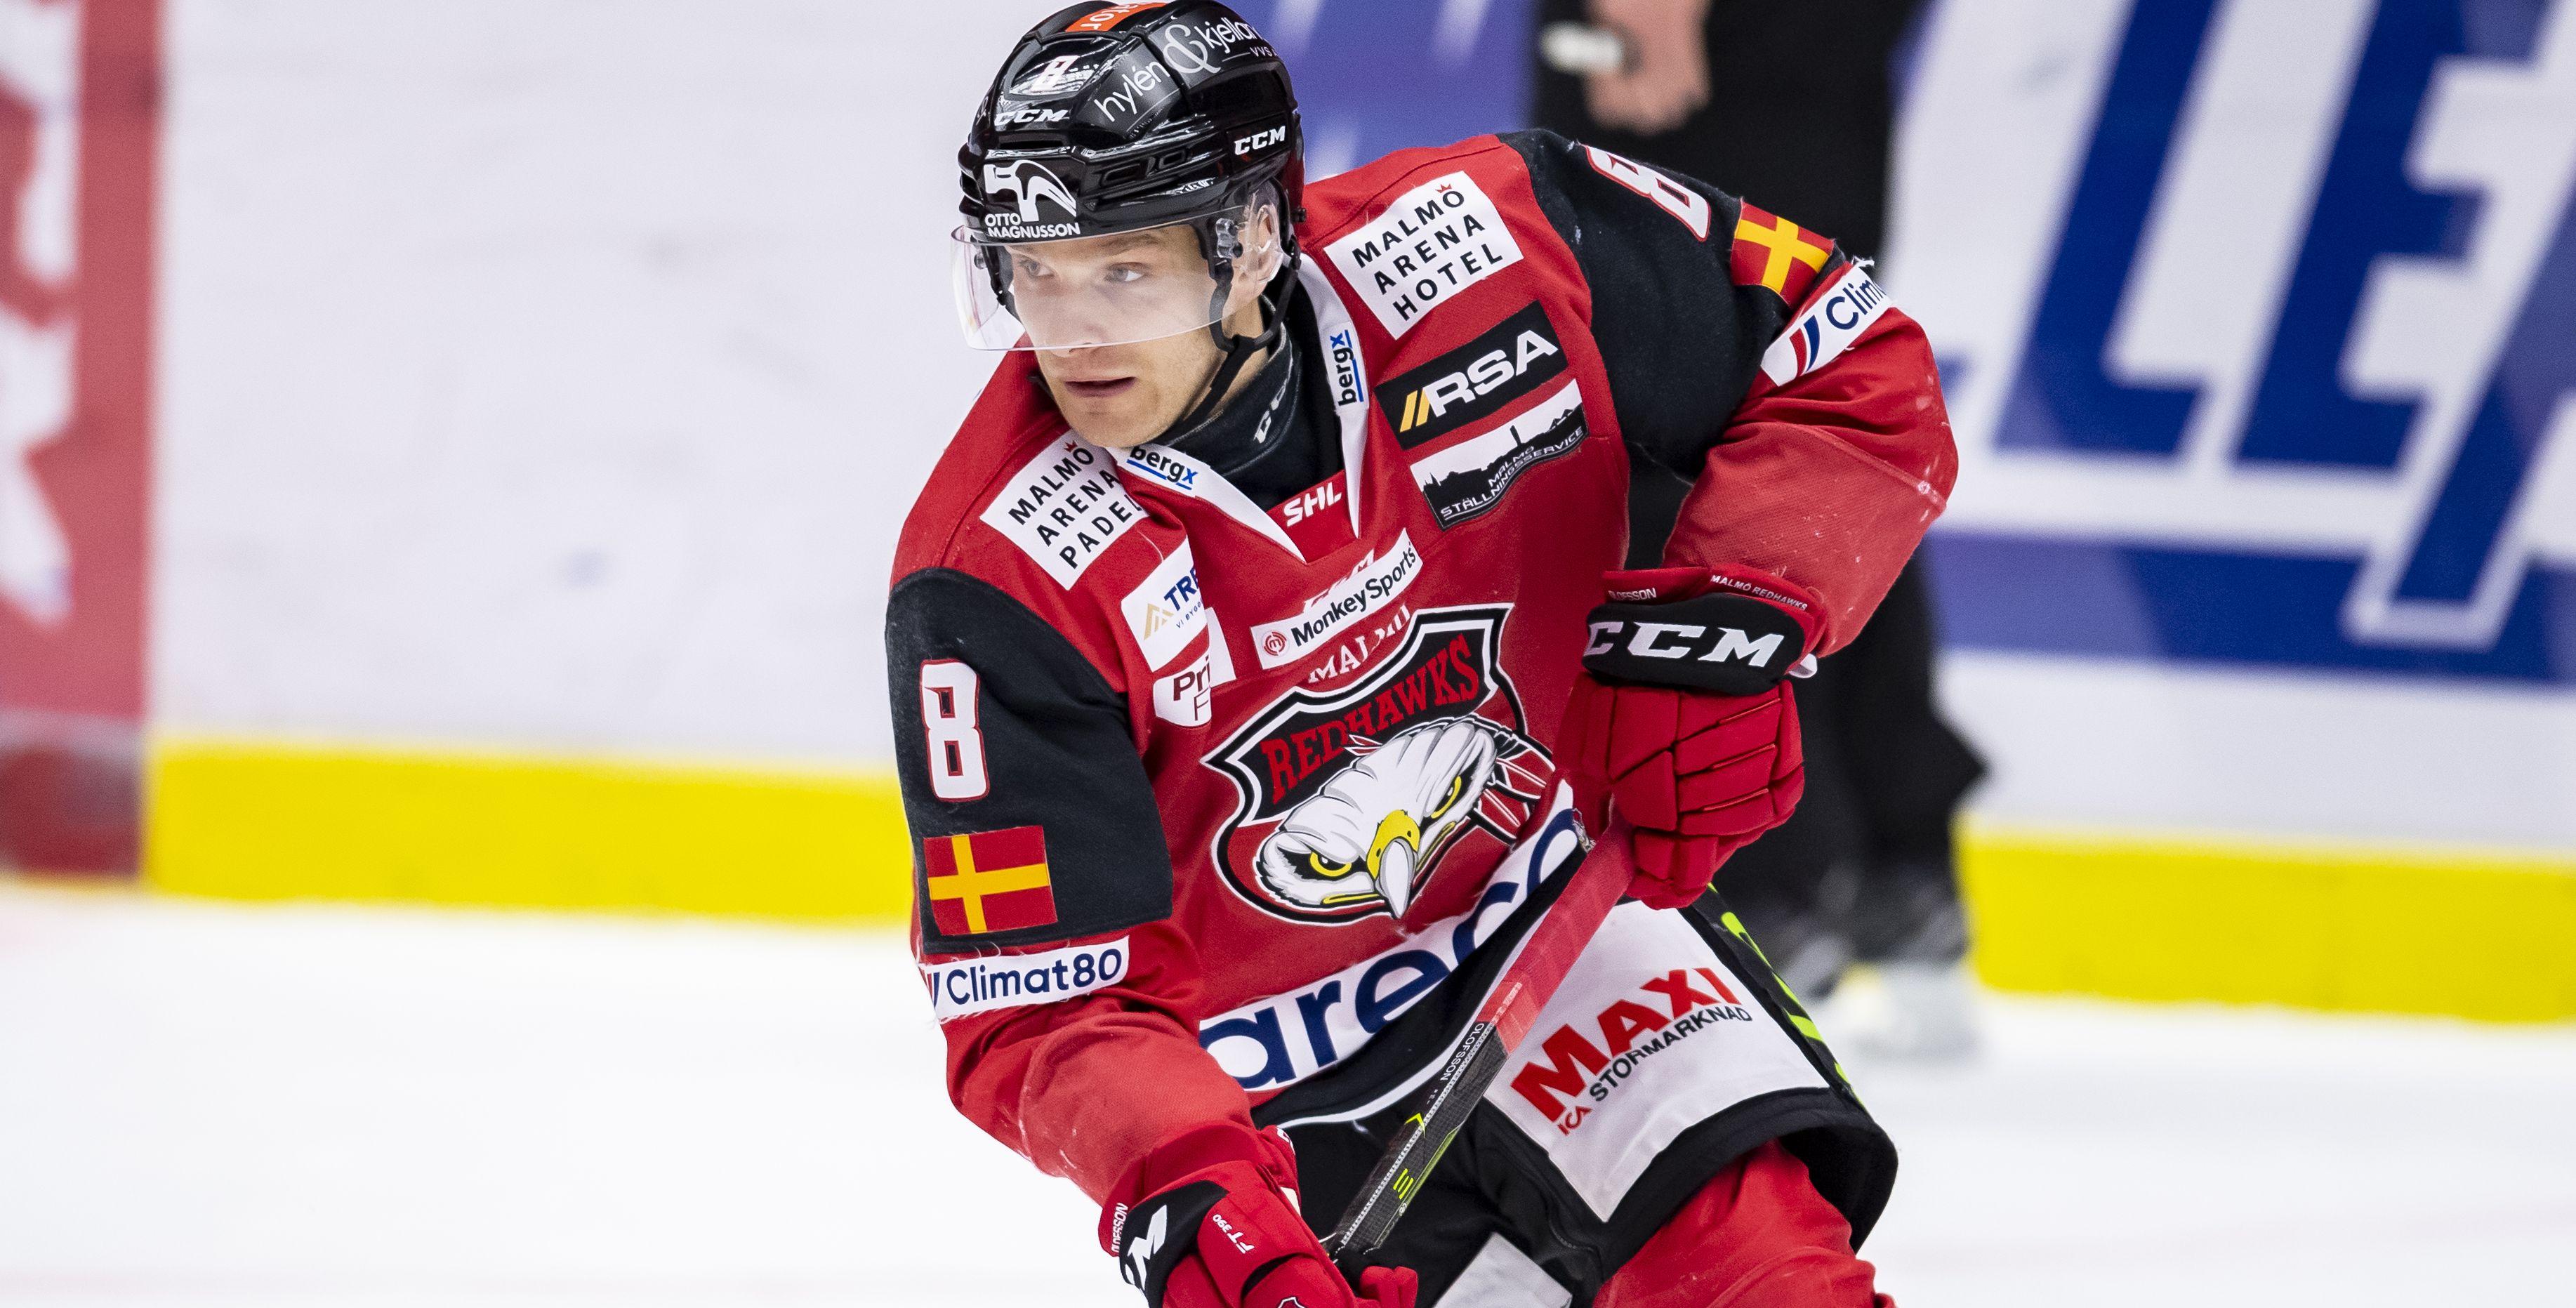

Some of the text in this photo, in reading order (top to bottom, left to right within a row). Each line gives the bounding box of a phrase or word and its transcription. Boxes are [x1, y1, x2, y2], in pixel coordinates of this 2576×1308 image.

[1094, 60, 1170, 122] hylén
[1163, 24, 1221, 74] &
[994, 109, 1070, 126] CCM
[1234, 126, 1286, 155] CCM
[984, 212, 1021, 227] OTTO
[988, 222, 1081, 239] MAGNUSSON
[1374, 214, 1486, 294] ARENA
[1393, 244, 1502, 321] HOTEL
[1826, 279, 1886, 330] Clim
[1330, 333, 1358, 407] bergx
[1130, 445, 1198, 484] bergx
[1441, 426, 1584, 517] STÄLLNINGSSERVICE
[1037, 471, 1121, 546] ARENA
[1059, 493, 1144, 569] PADEL
[1283, 482, 1342, 527] SHL
[1291, 546, 1417, 646] MonkeySports
[1710, 574, 1808, 612] MALMÖ REDHAWKS
[1583, 621, 1784, 668] CCM
[919, 658, 991, 802] 8
[1261, 633, 1479, 805] REDHAWKS
[946, 948, 1123, 1005] Climat80
[1441, 1022, 1484, 1082] OLOFSSON
[1511, 967, 1741, 1123] MAXI
[1557, 1007, 1752, 1136] ICA STORMARKNAD
